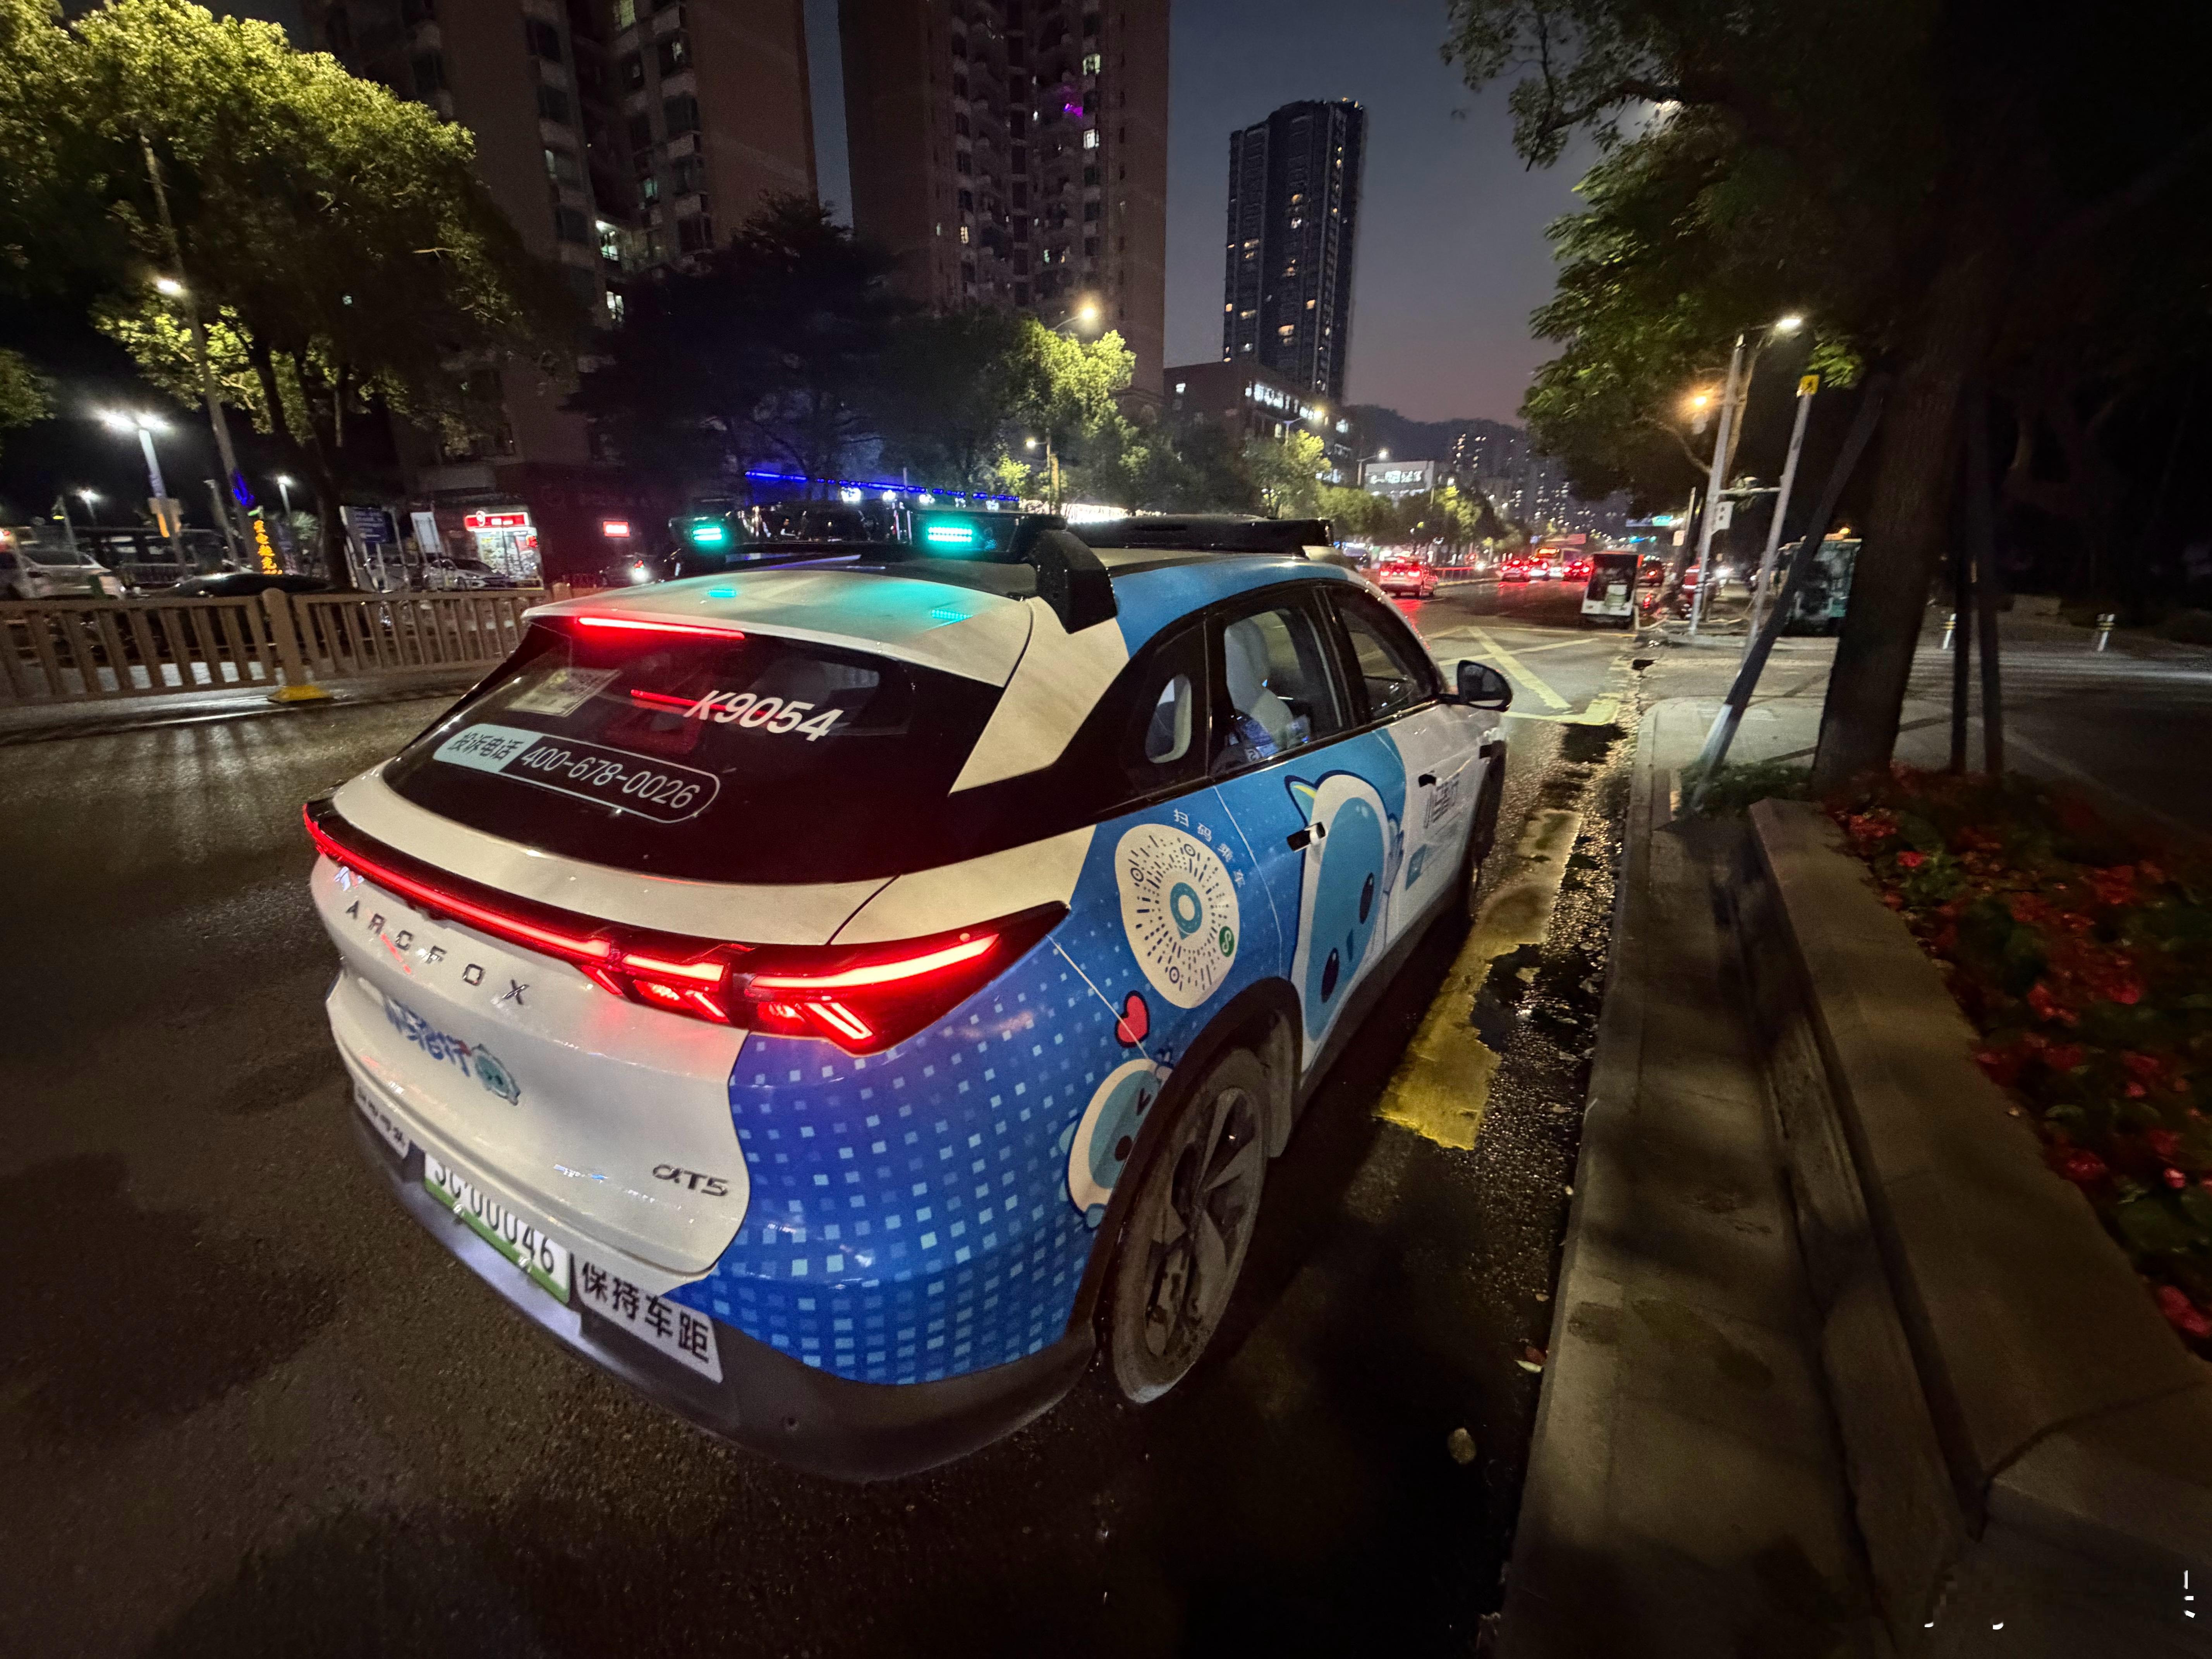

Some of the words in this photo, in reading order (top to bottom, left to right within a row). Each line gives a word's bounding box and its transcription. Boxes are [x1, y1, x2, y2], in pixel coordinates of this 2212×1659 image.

[684, 690, 845, 742] K9054
[447, 732, 524, 760] 投诉电话
[521, 746, 701, 809] 400-678-0026
[345, 900, 530, 1006] ARCFOX
[582, 1261, 709, 1364] 保持车距
